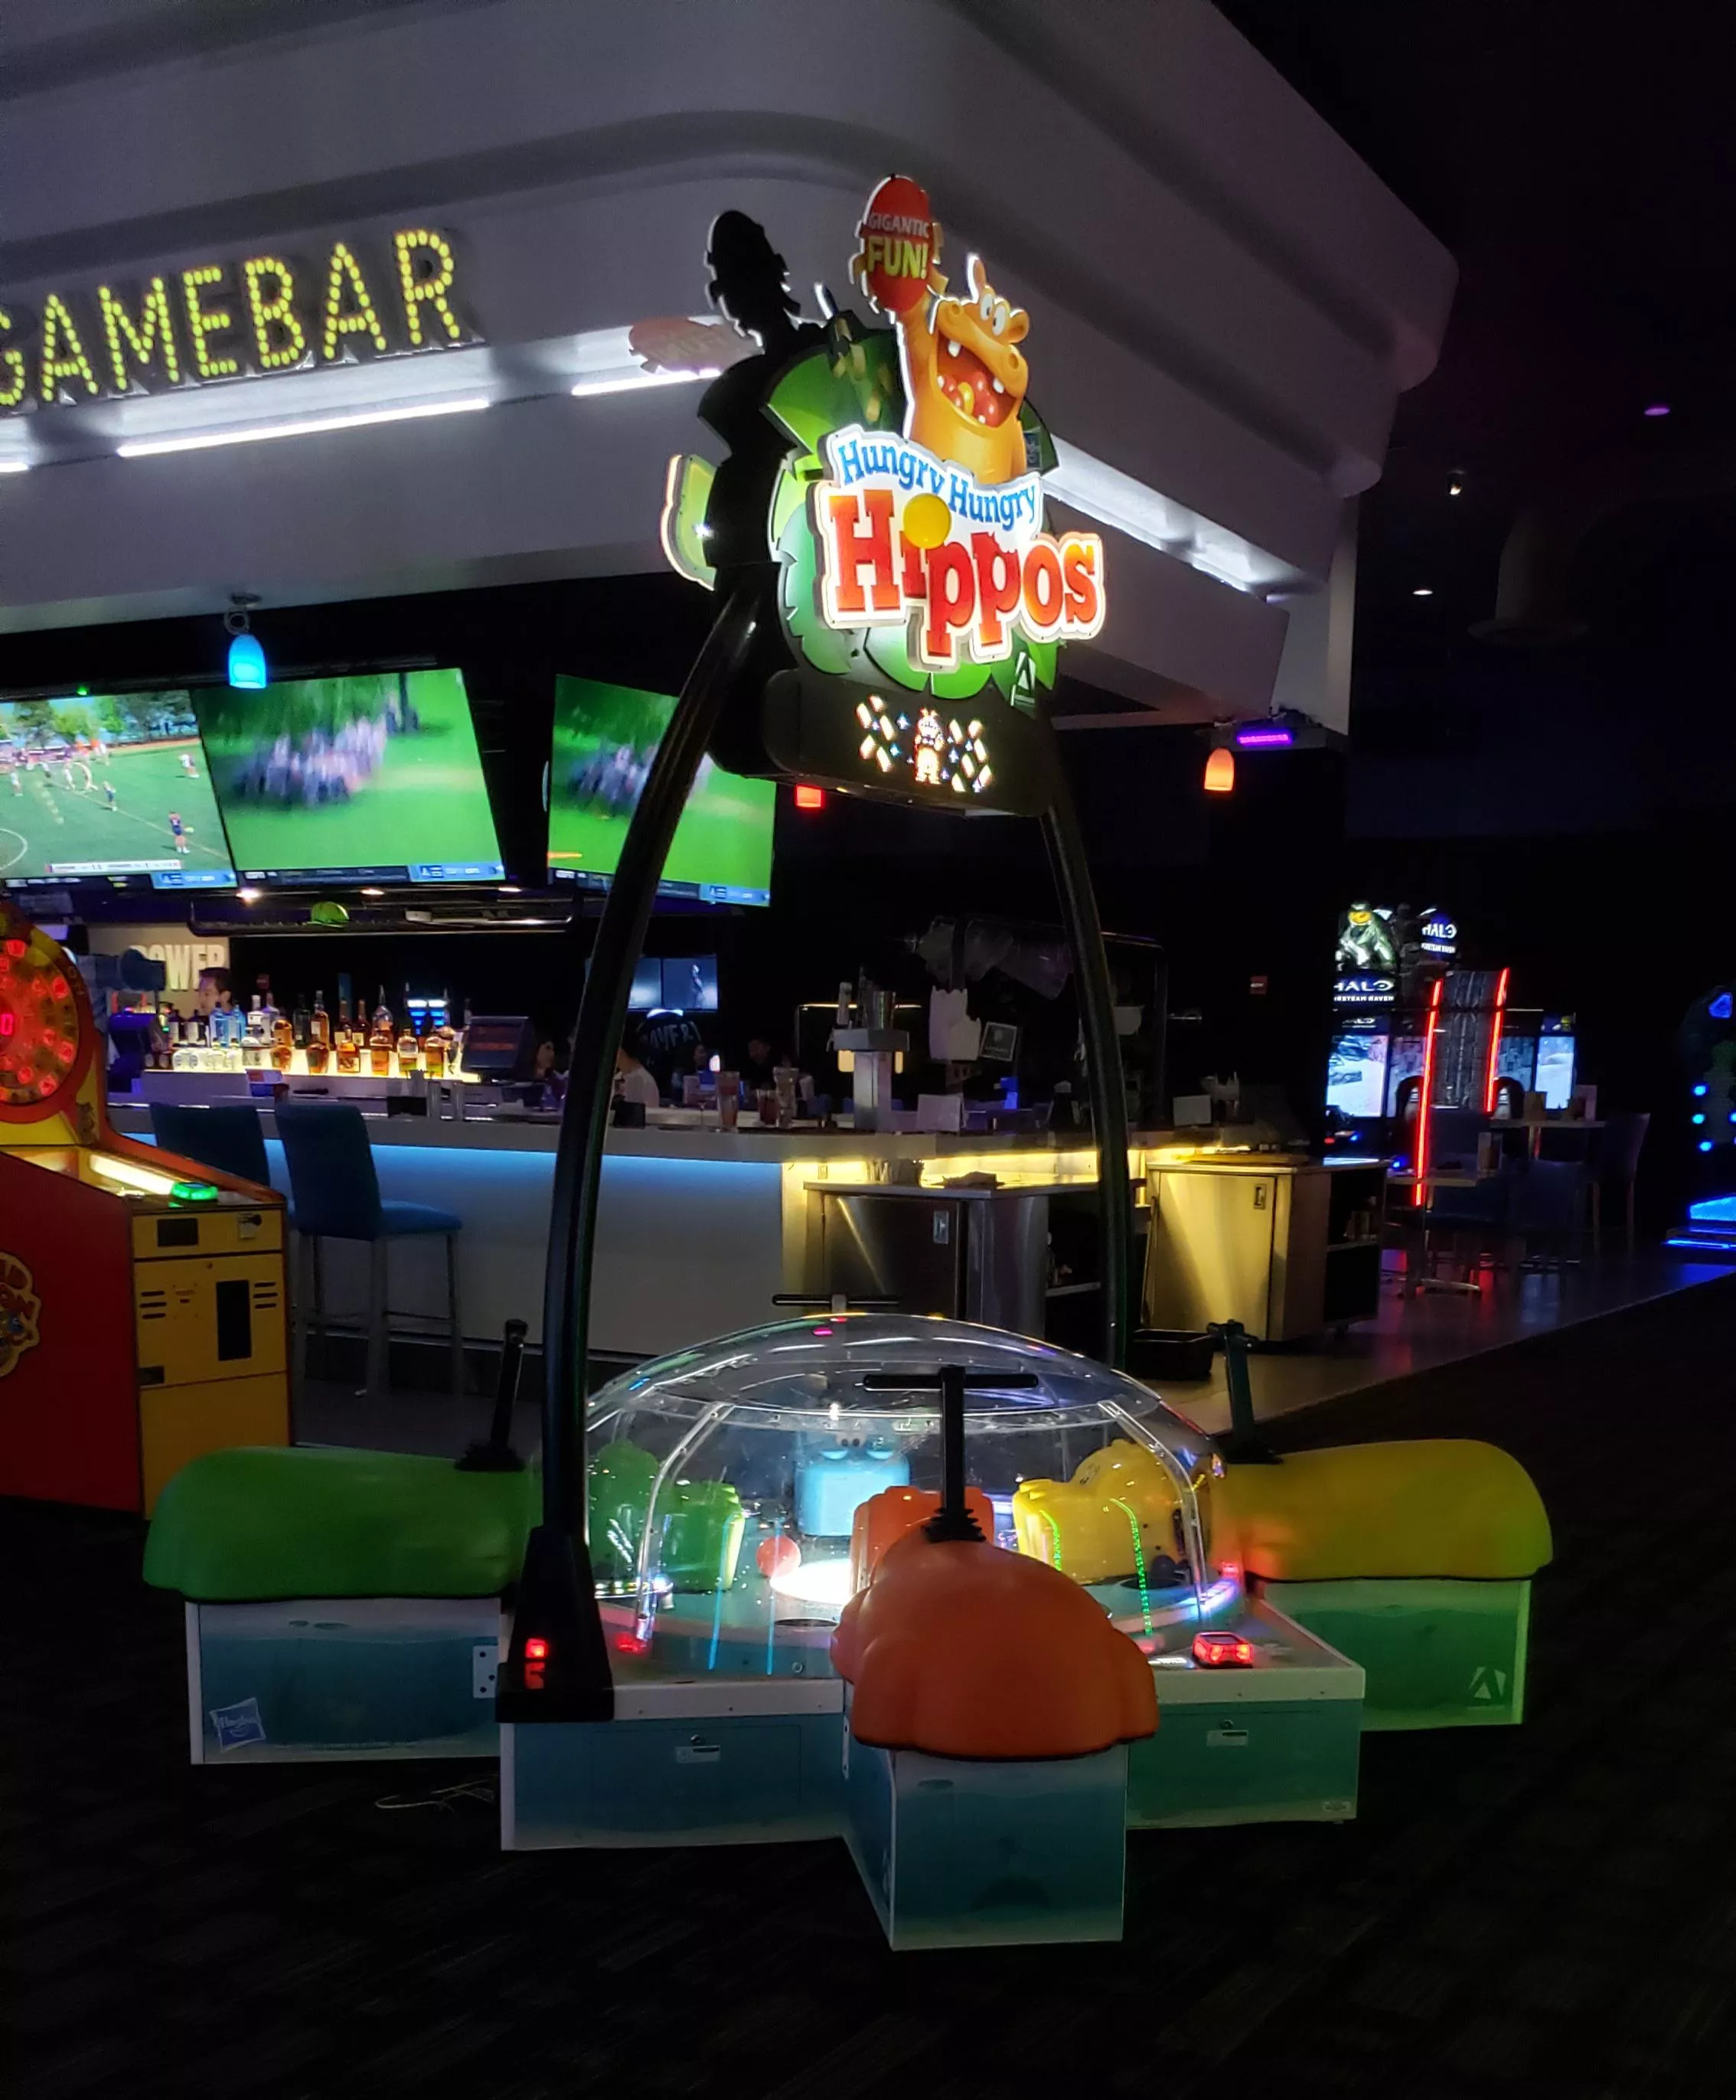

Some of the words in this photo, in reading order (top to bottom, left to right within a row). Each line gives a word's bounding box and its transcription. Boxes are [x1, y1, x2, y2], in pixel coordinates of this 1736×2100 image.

[868, 214, 929, 238] GIGANTIC
[867, 235, 928, 279] FUN!
[838, 439, 946, 495] Hungry
[948, 472, 1036, 531] Hungry
[129, 945, 225, 990] WER
